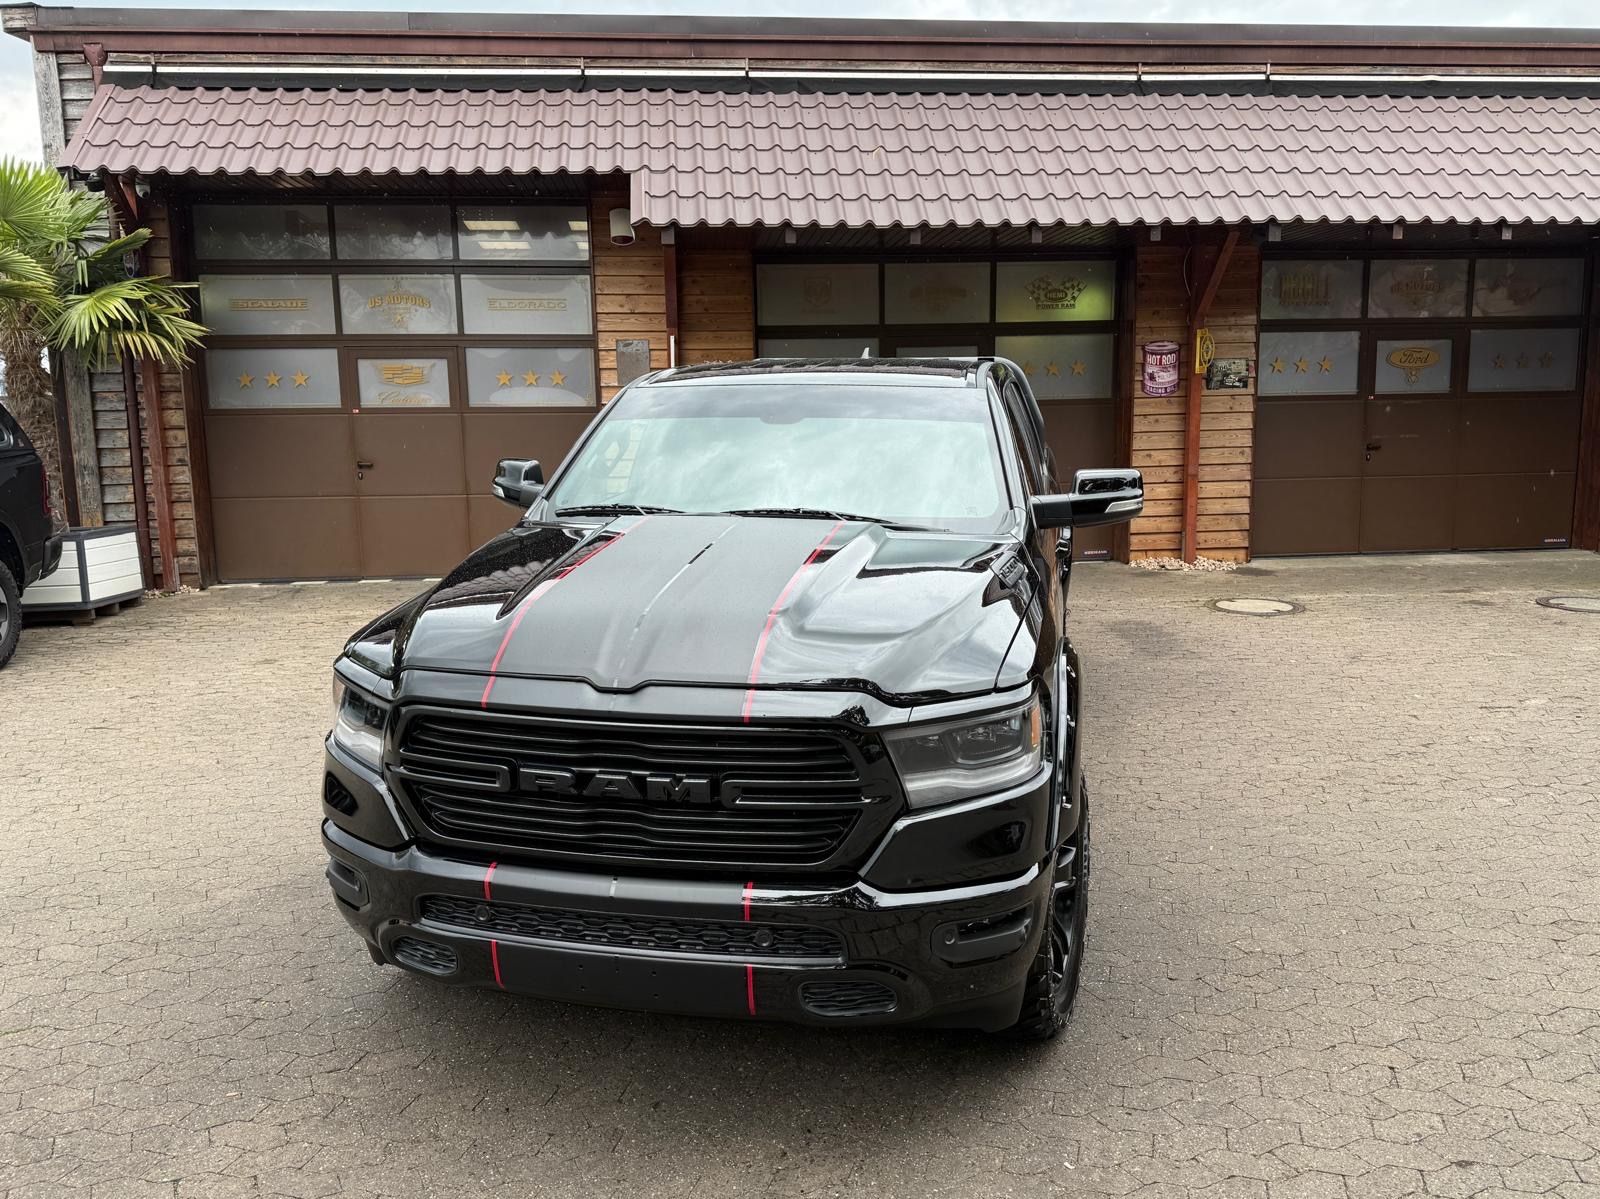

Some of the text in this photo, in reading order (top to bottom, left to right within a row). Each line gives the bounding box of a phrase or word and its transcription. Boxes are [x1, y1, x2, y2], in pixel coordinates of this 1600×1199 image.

[368, 295, 432, 309] US MOTORS
[488, 300, 567, 310] ELDORADO
[1147, 353, 1176, 365] HOT ROD
[1400, 351, 1430, 364] Ford
[519, 767, 710, 804] RAM
